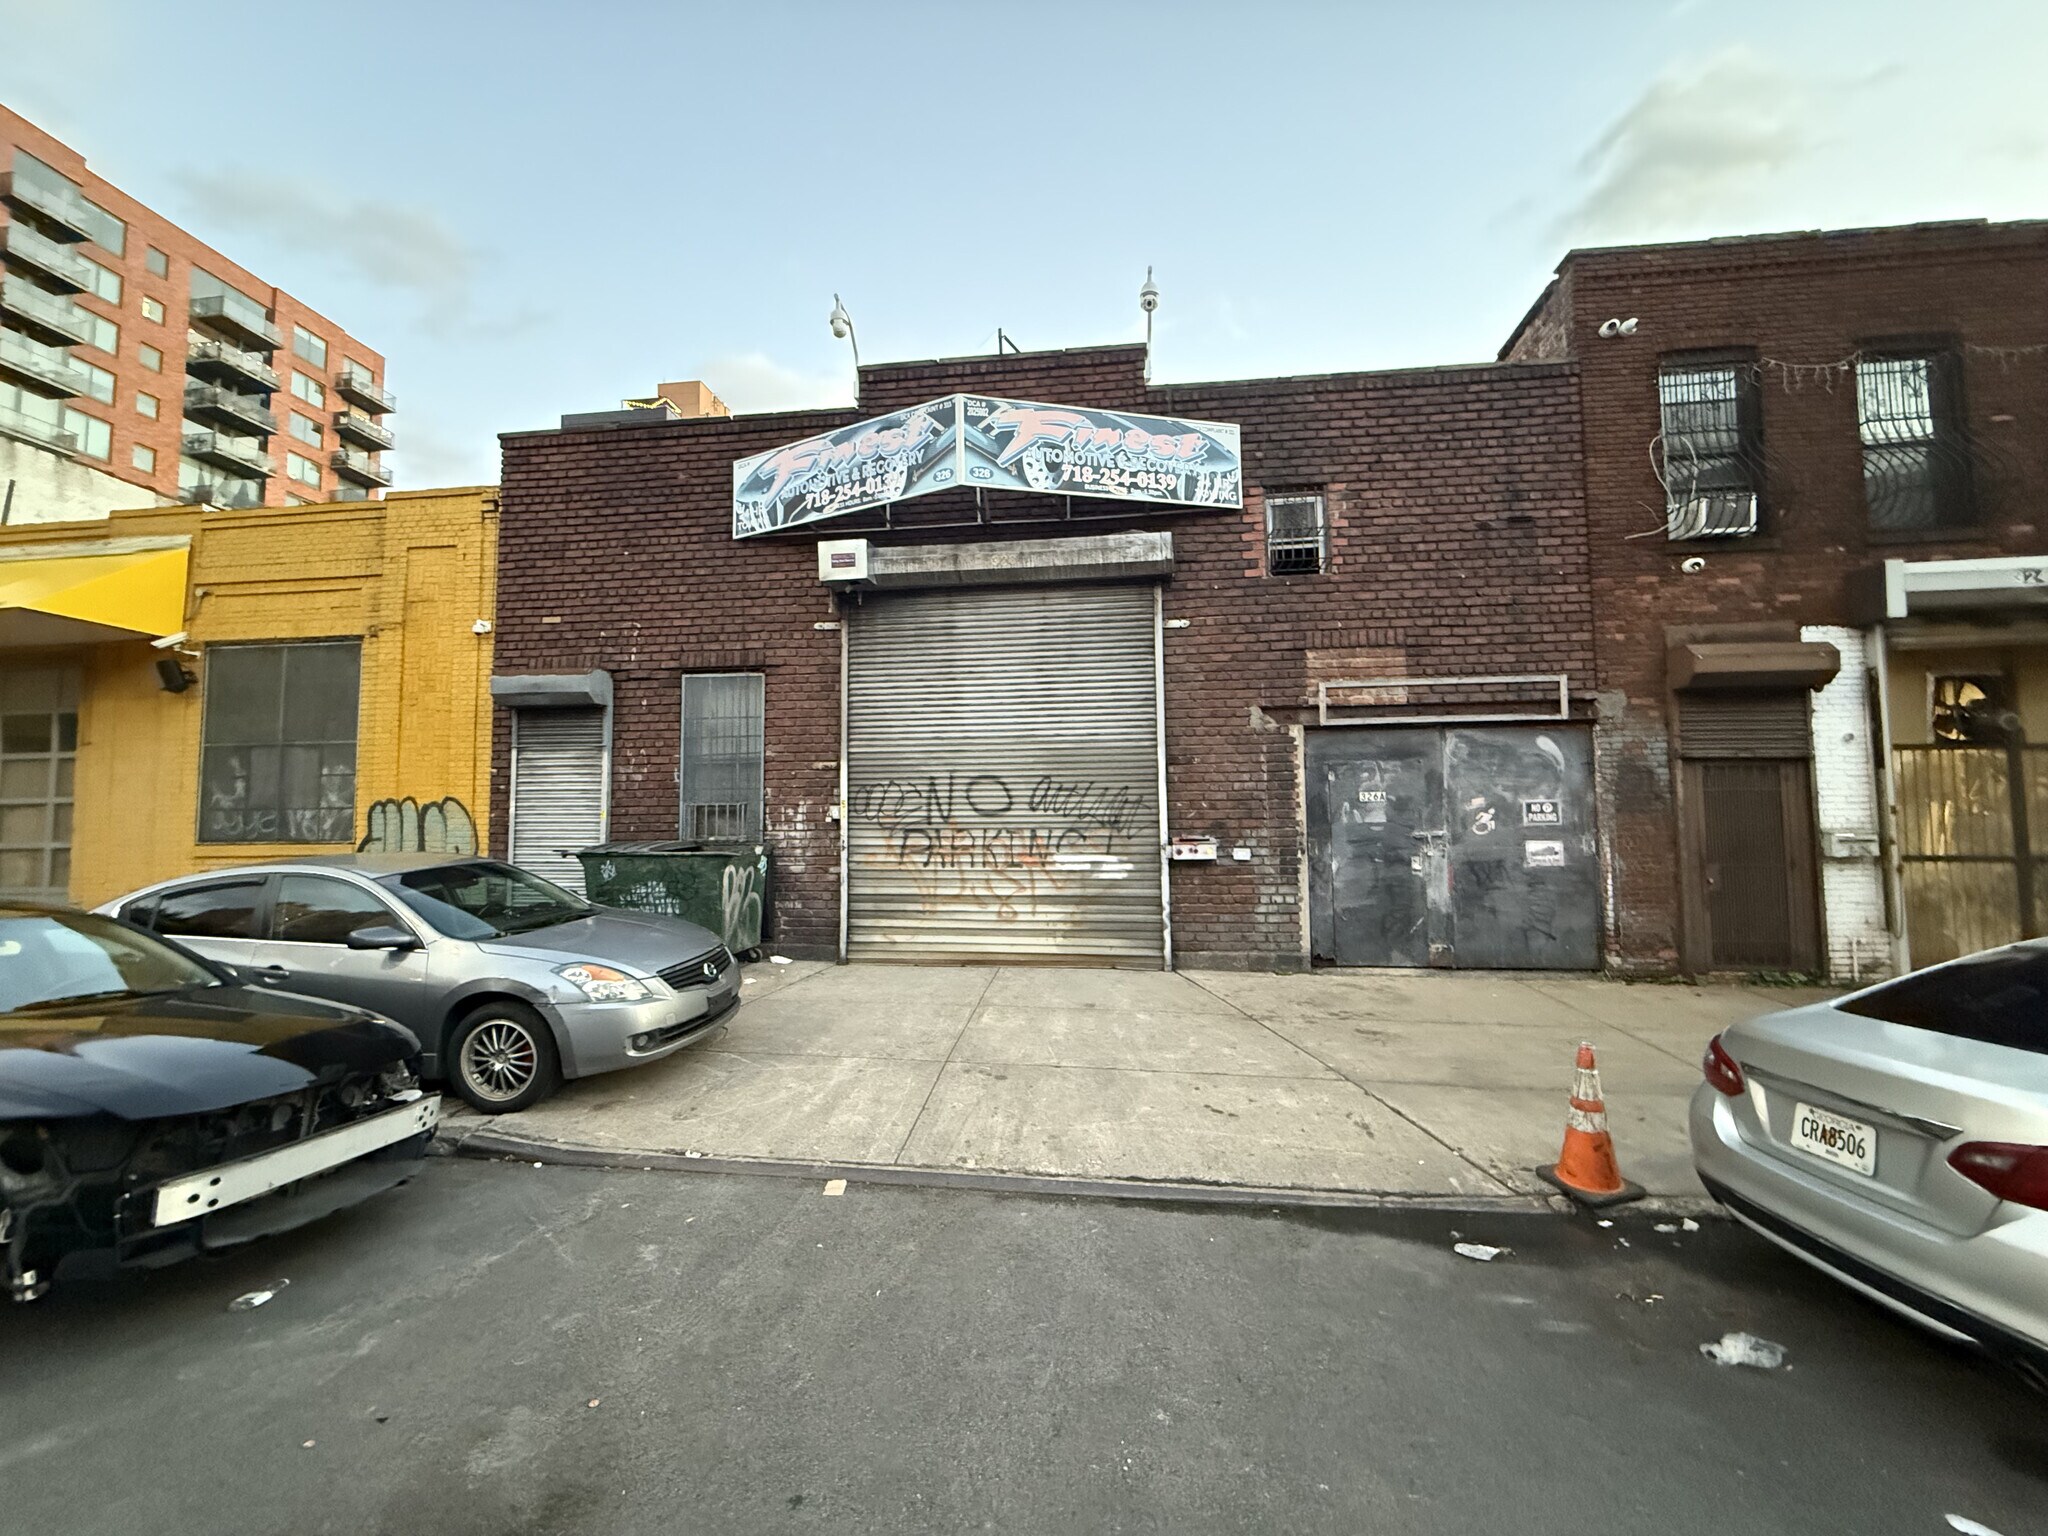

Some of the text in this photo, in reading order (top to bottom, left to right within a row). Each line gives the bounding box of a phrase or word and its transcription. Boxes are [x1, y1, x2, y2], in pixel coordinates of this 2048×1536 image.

[990, 408, 1208, 468] Finest
[780, 467, 851, 500] AUTOMTIVE
[851, 464, 861, 480] &
[935, 470, 952, 481] 326
[973, 469, 990, 478] 326
[1062, 464, 1177, 490] 718-254-0139
[926, 775, 1013, 825] NO
[1361, 793, 1385, 801] 326A
[1531, 803, 1541, 812] NO
[1528, 813, 1557, 821] PARKING
[1813, 1110, 1856, 1132] GEORGIA
[1801, 1117, 1865, 1159] CRA8506
